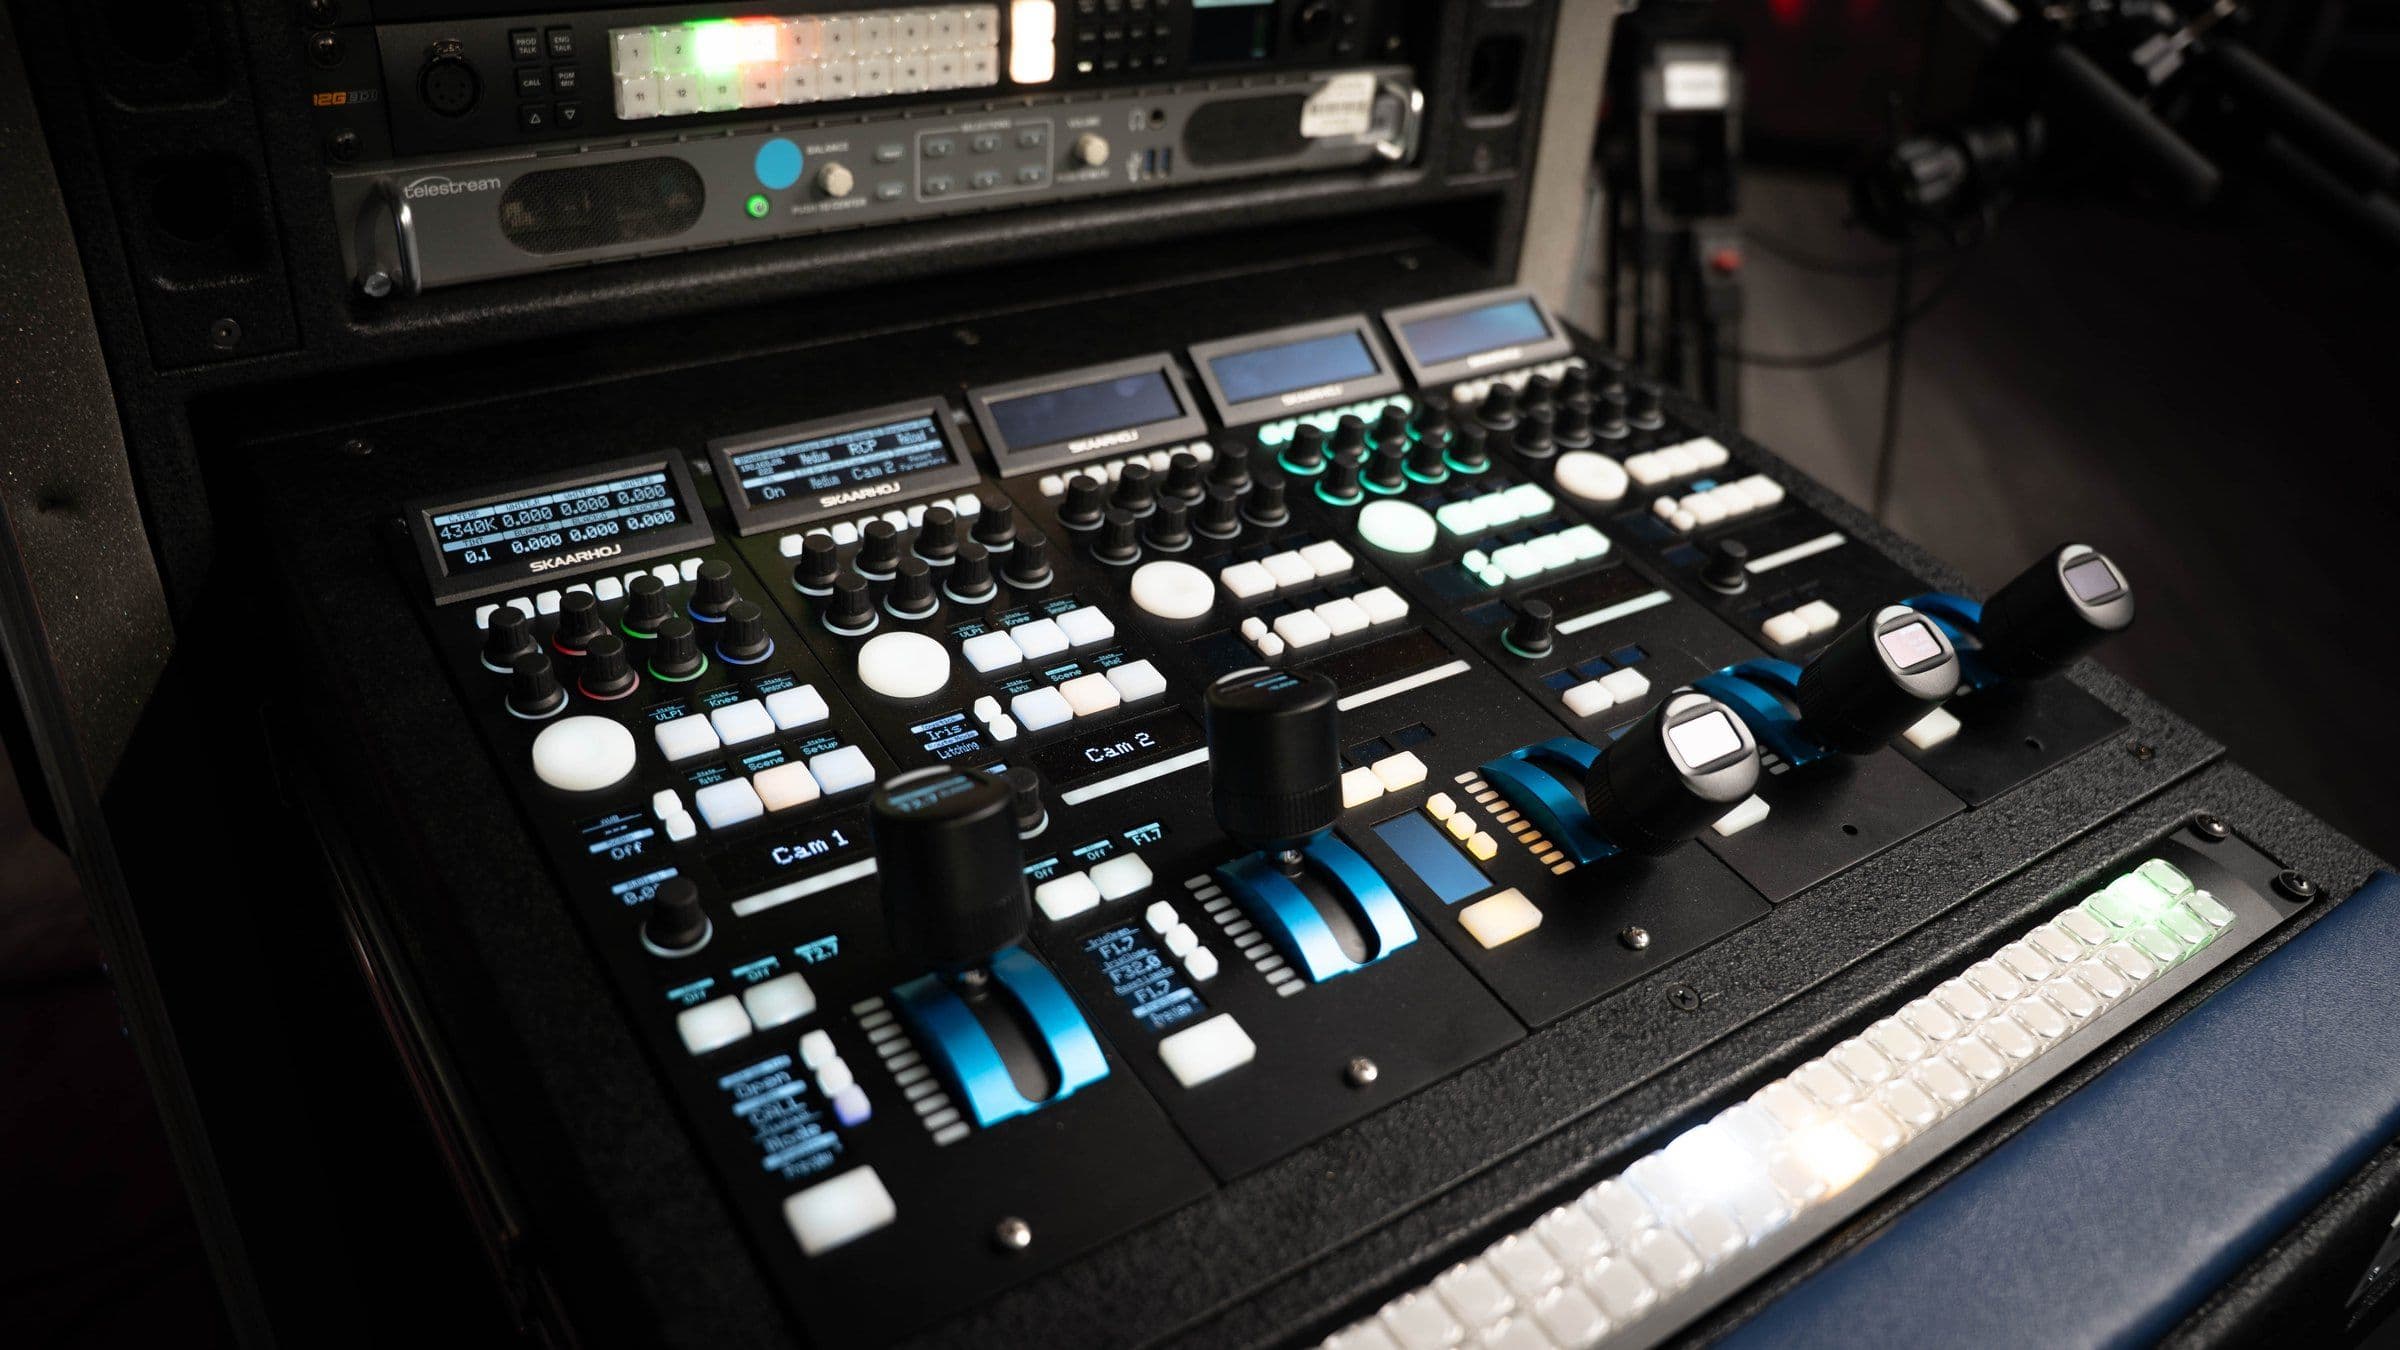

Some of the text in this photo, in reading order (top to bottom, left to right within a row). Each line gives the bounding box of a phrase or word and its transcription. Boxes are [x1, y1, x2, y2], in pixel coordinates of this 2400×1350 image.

[522, 78, 541, 87] CALL
[403, 177, 502, 199] telestream
[847, 438, 878, 456] RCP
[850, 465, 883, 481] Cam
[883, 460, 897, 474] 2
[762, 485, 786, 500] On
[820, 481, 901, 508] SKAARHOJ
[439, 484, 666, 540] 4340K 0.000 0.000 0.000
[464, 510, 676, 564] 0.1 0.000 0.000 0.000
[529, 543, 622, 574] SKAARHOJ
[1005, 615, 1031, 627] Knee
[1050, 669, 1082, 682] Scene
[709, 694, 739, 708] Knee
[926, 725, 962, 741] Iris
[802, 741, 838, 756] Setup
[936, 741, 980, 759] Latching
[1084, 732, 1156, 763] Cam 2
[748, 756, 785, 771] Scene
[1131, 828, 1162, 846] F1.7
[610, 841, 643, 860] Off
[771, 829, 849, 866] Cam 1
[1086, 848, 1106, 861] Off
[1033, 866, 1055, 880] Off
[1099, 935, 1135, 960] F1.7
[1134, 979, 1171, 1004] F1.7
